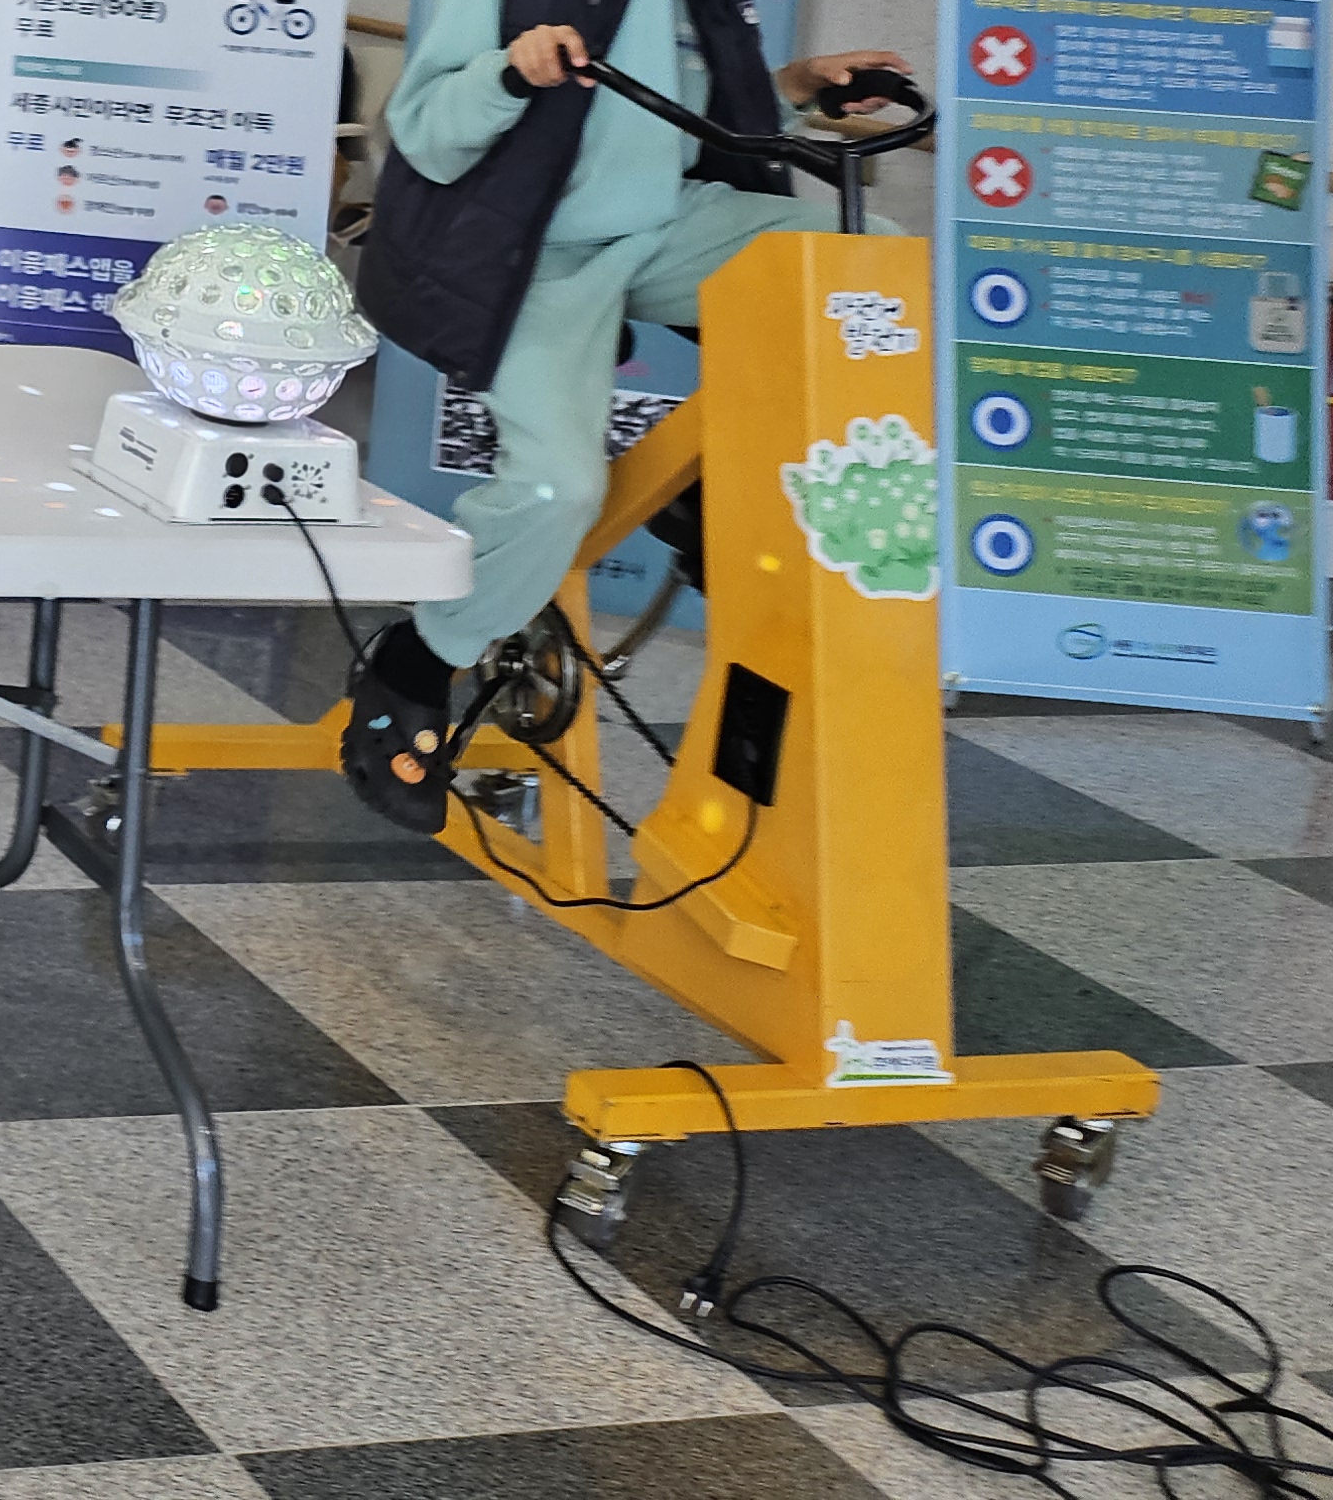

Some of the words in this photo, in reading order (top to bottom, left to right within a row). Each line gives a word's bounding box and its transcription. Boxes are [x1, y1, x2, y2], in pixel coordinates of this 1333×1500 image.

[14, 17, 56, 38] 무료
[10, 92, 154, 125] 세종시민이라면
[164, 105, 227, 130] 무조건
[231, 111, 277, 134] 이득
[5, 131, 46, 151] 무료
[205, 149, 246, 171] 매월
[250, 153, 306, 177] 2만원
